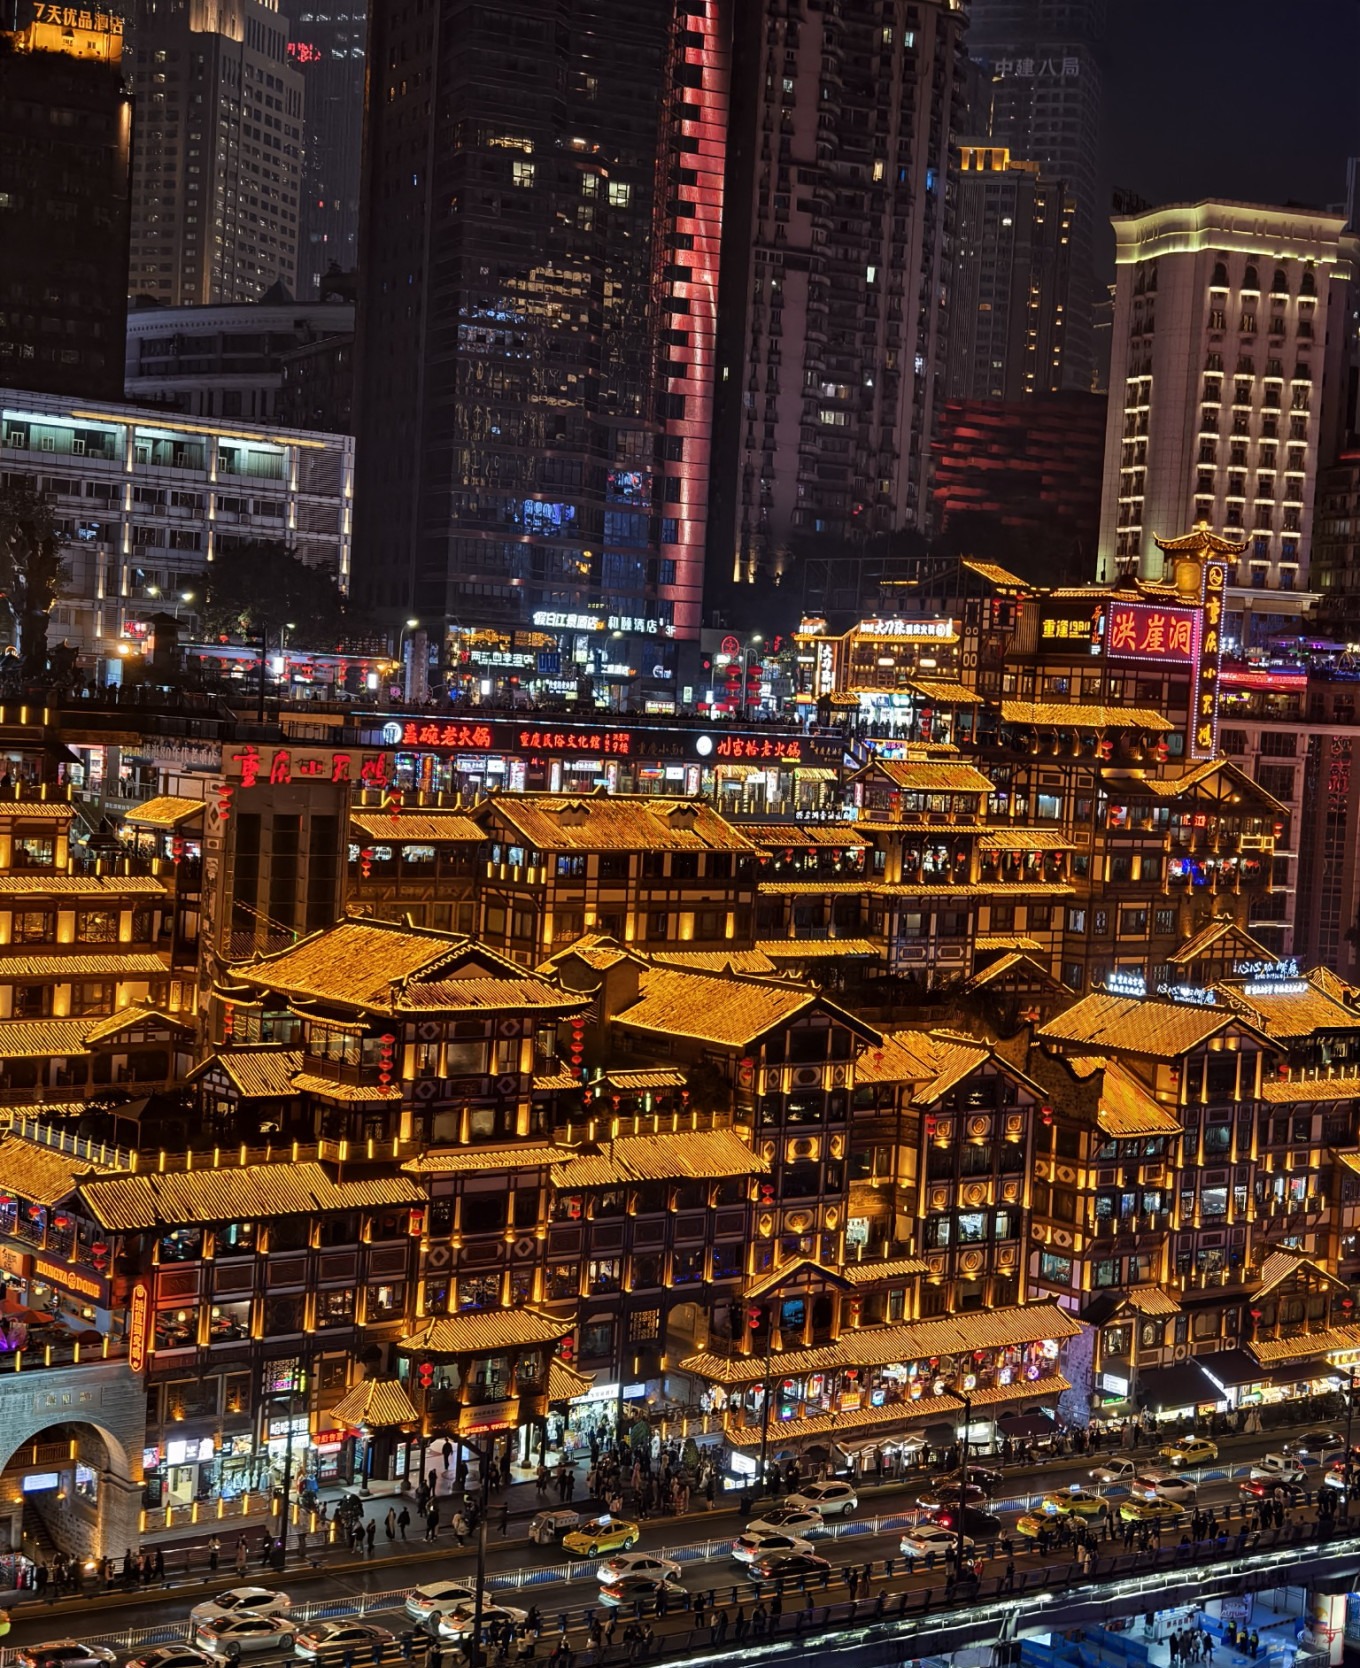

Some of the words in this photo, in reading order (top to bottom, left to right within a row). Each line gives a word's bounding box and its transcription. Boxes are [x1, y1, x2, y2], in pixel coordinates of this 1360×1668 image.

[33, 2, 123, 35] 7天优品酒店
[995, 57, 1080, 78] 中建八局
[608, 615, 658, 634] 和颐酒店
[665, 625, 676, 637] 3F
[1111, 611, 1192, 655] 洪崖洞
[402, 723, 492, 747] 盖碗老火锅
[233, 745, 388, 788] 重庆小天鹅
[36, 1260, 68, 1286] HONGYA
[76, 1283, 101, 1299] DONG
